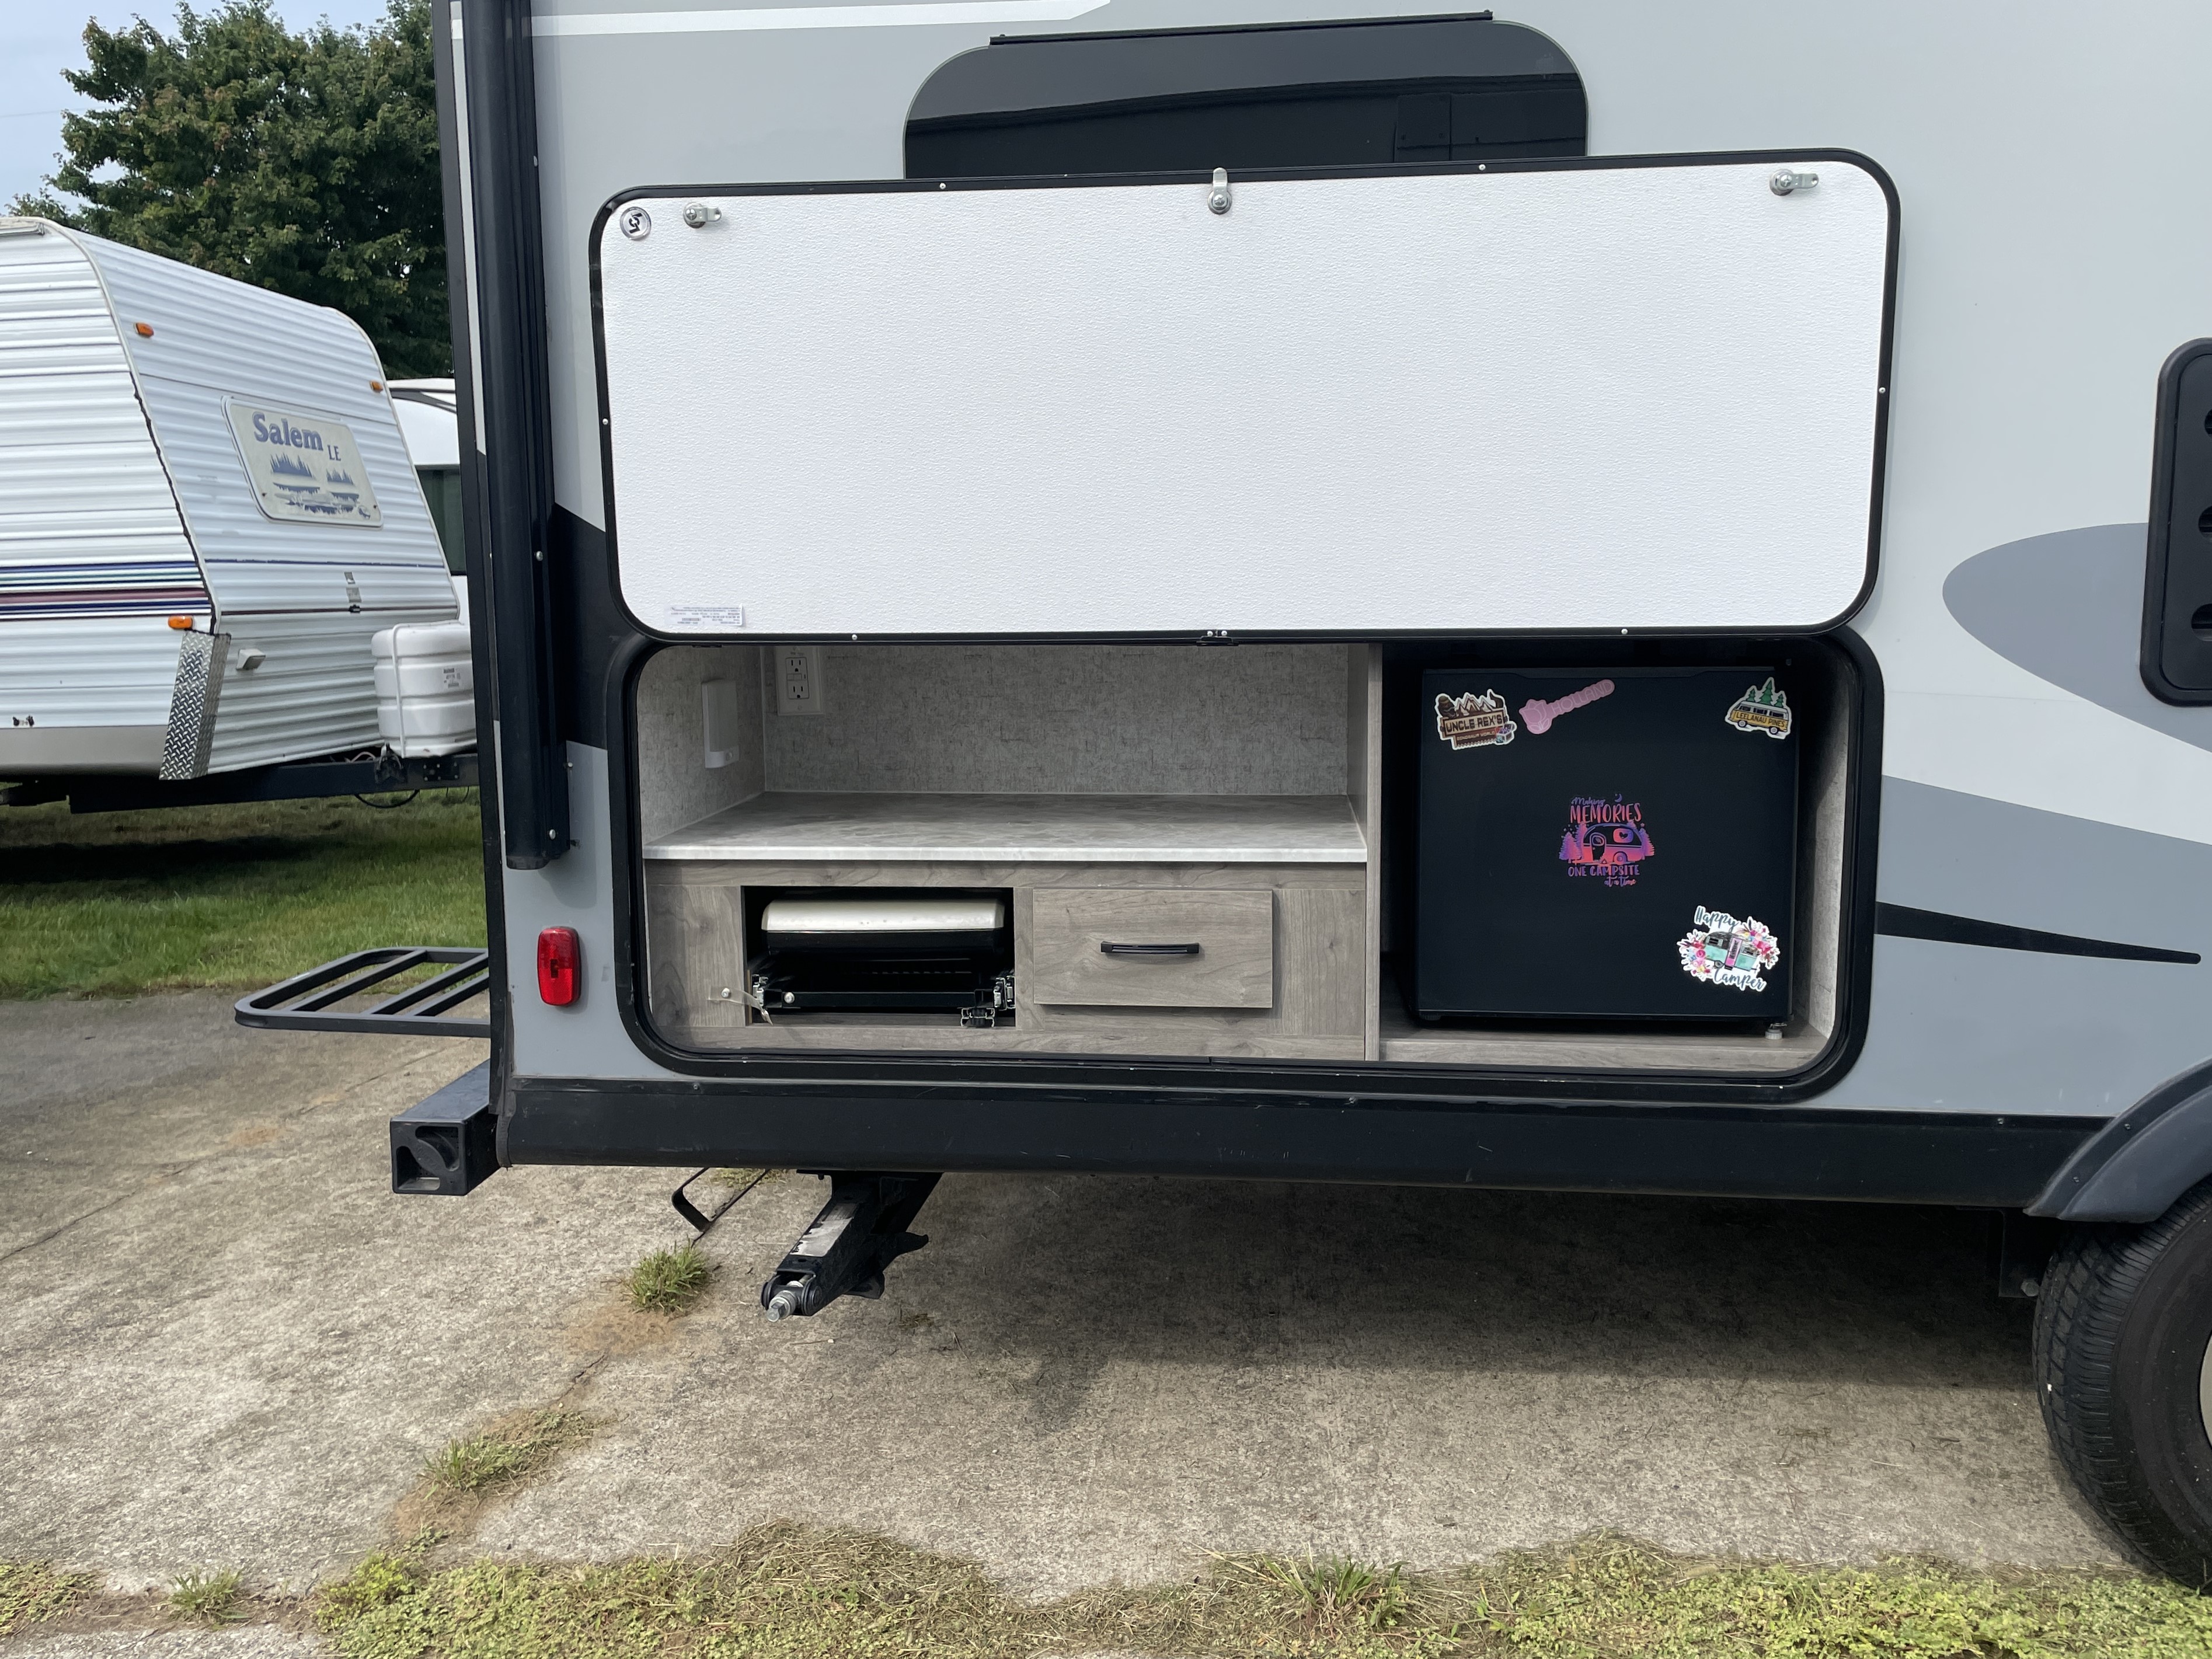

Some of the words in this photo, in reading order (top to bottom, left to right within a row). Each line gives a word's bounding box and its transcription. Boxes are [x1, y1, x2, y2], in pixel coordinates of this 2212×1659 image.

[252, 411, 323, 451] Salem
[328, 445, 342, 461] LE
[1551, 682, 1613, 715] HOLLAND
[1446, 719, 1475, 733] UNCLE
[1477, 715, 1503, 729] REX'S
[1736, 712, 1767, 724] LEELANAU
[1768, 717, 1785, 727] PINES
[1571, 796, 1605, 807] Making
[1570, 803, 1642, 824] MEMORIES
[1567, 866, 1587, 877] ONE
[1589, 865, 1640, 876] CAMPSITE
[1604, 876, 1618, 887] at
[1618, 876, 1636, 887] time
[1695, 907, 1739, 933] Happy
[1714, 967, 1765, 989] Camper
